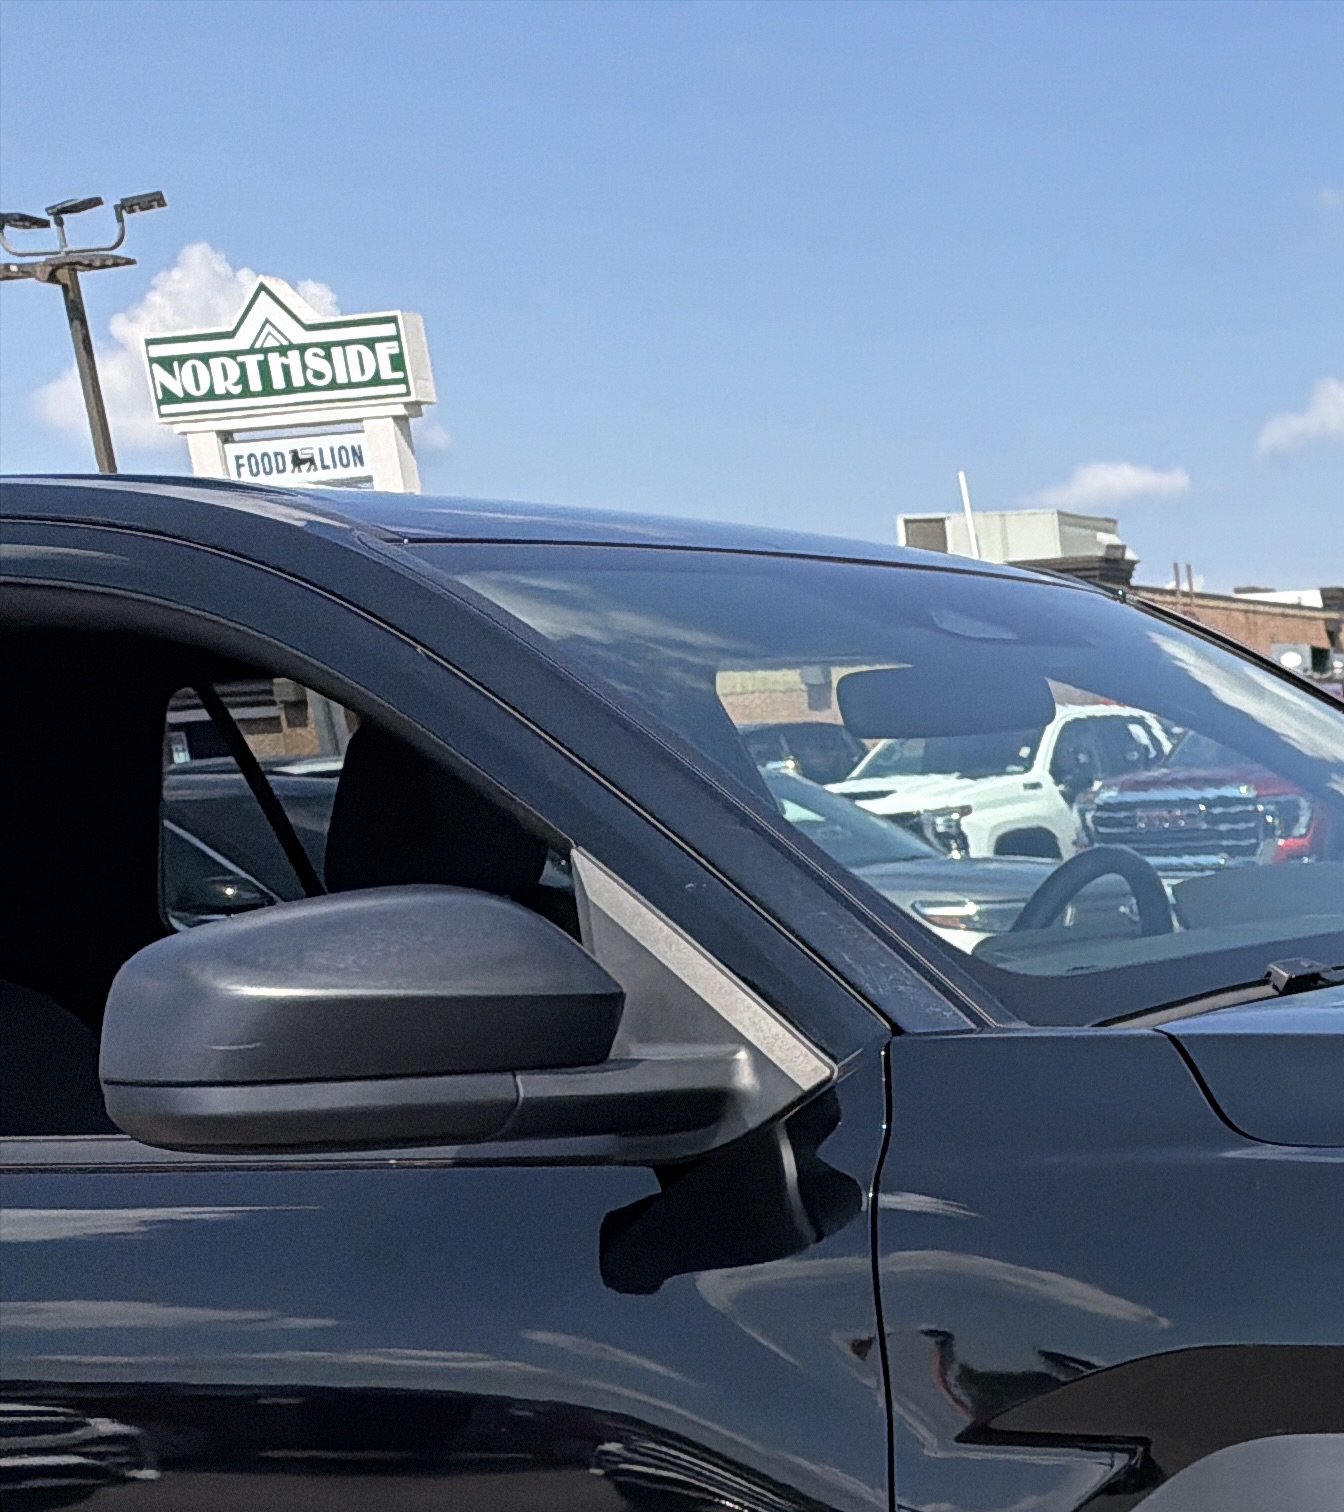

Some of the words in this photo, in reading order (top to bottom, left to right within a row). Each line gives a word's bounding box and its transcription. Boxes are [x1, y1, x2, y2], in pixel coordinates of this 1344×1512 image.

[152, 341, 404, 400] NORTHSIDE
[234, 453, 287, 478] FOOD
[318, 444, 365, 470] LION
